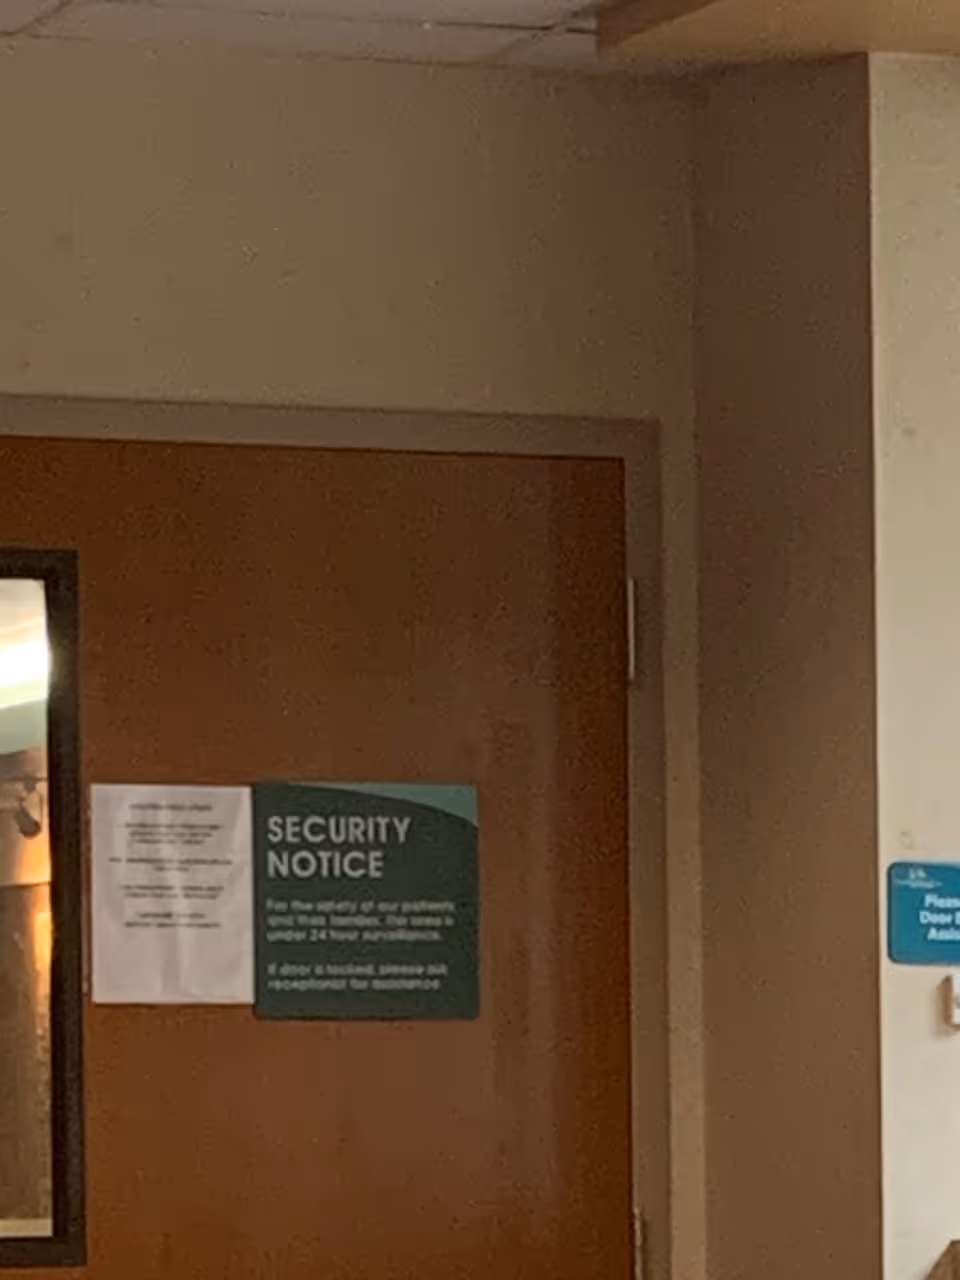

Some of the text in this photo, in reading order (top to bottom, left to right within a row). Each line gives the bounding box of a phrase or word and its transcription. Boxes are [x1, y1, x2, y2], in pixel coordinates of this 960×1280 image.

[267, 815, 410, 843] SECURITY
[267, 850, 384, 878] NOTICE
[266, 898, 455, 914] For the safety of our patients
[266, 914, 294, 926] and
[919, 911, 953, 925] Door
[266, 929, 306, 941] under
[309, 929, 326, 941] 24
[329, 929, 358, 941] hour
[279, 963, 311, 976] door
[378, 963, 424, 979] please
[267, 978, 347, 992] receptionist
[349, 978, 368, 990] for
